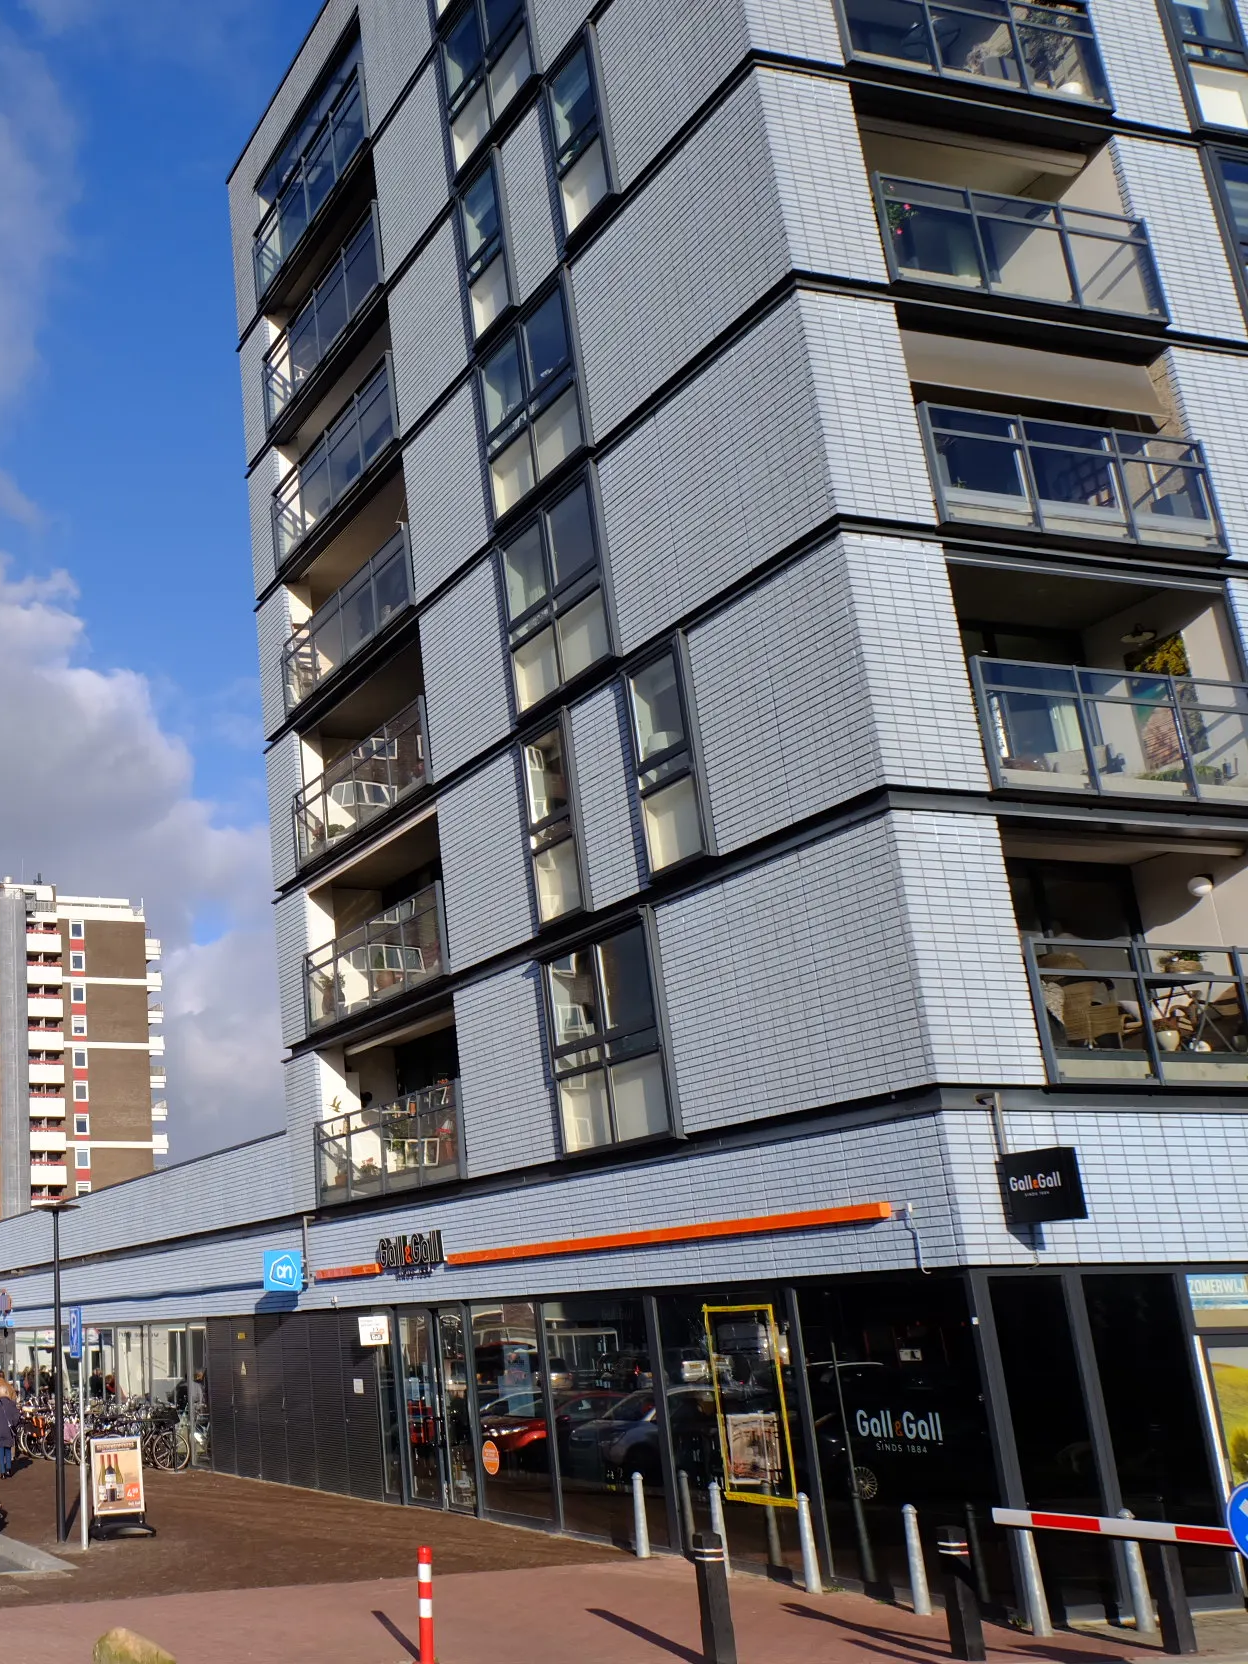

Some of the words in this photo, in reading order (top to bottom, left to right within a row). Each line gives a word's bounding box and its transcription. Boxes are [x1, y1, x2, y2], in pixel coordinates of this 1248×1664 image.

[1009, 1170, 1062, 1192] Gall&Gall
[856, 1409, 944, 1441] Gall&Gall
[875, 1442, 903, 1452] SINDS
[906, 1445, 928, 1454] 1884
